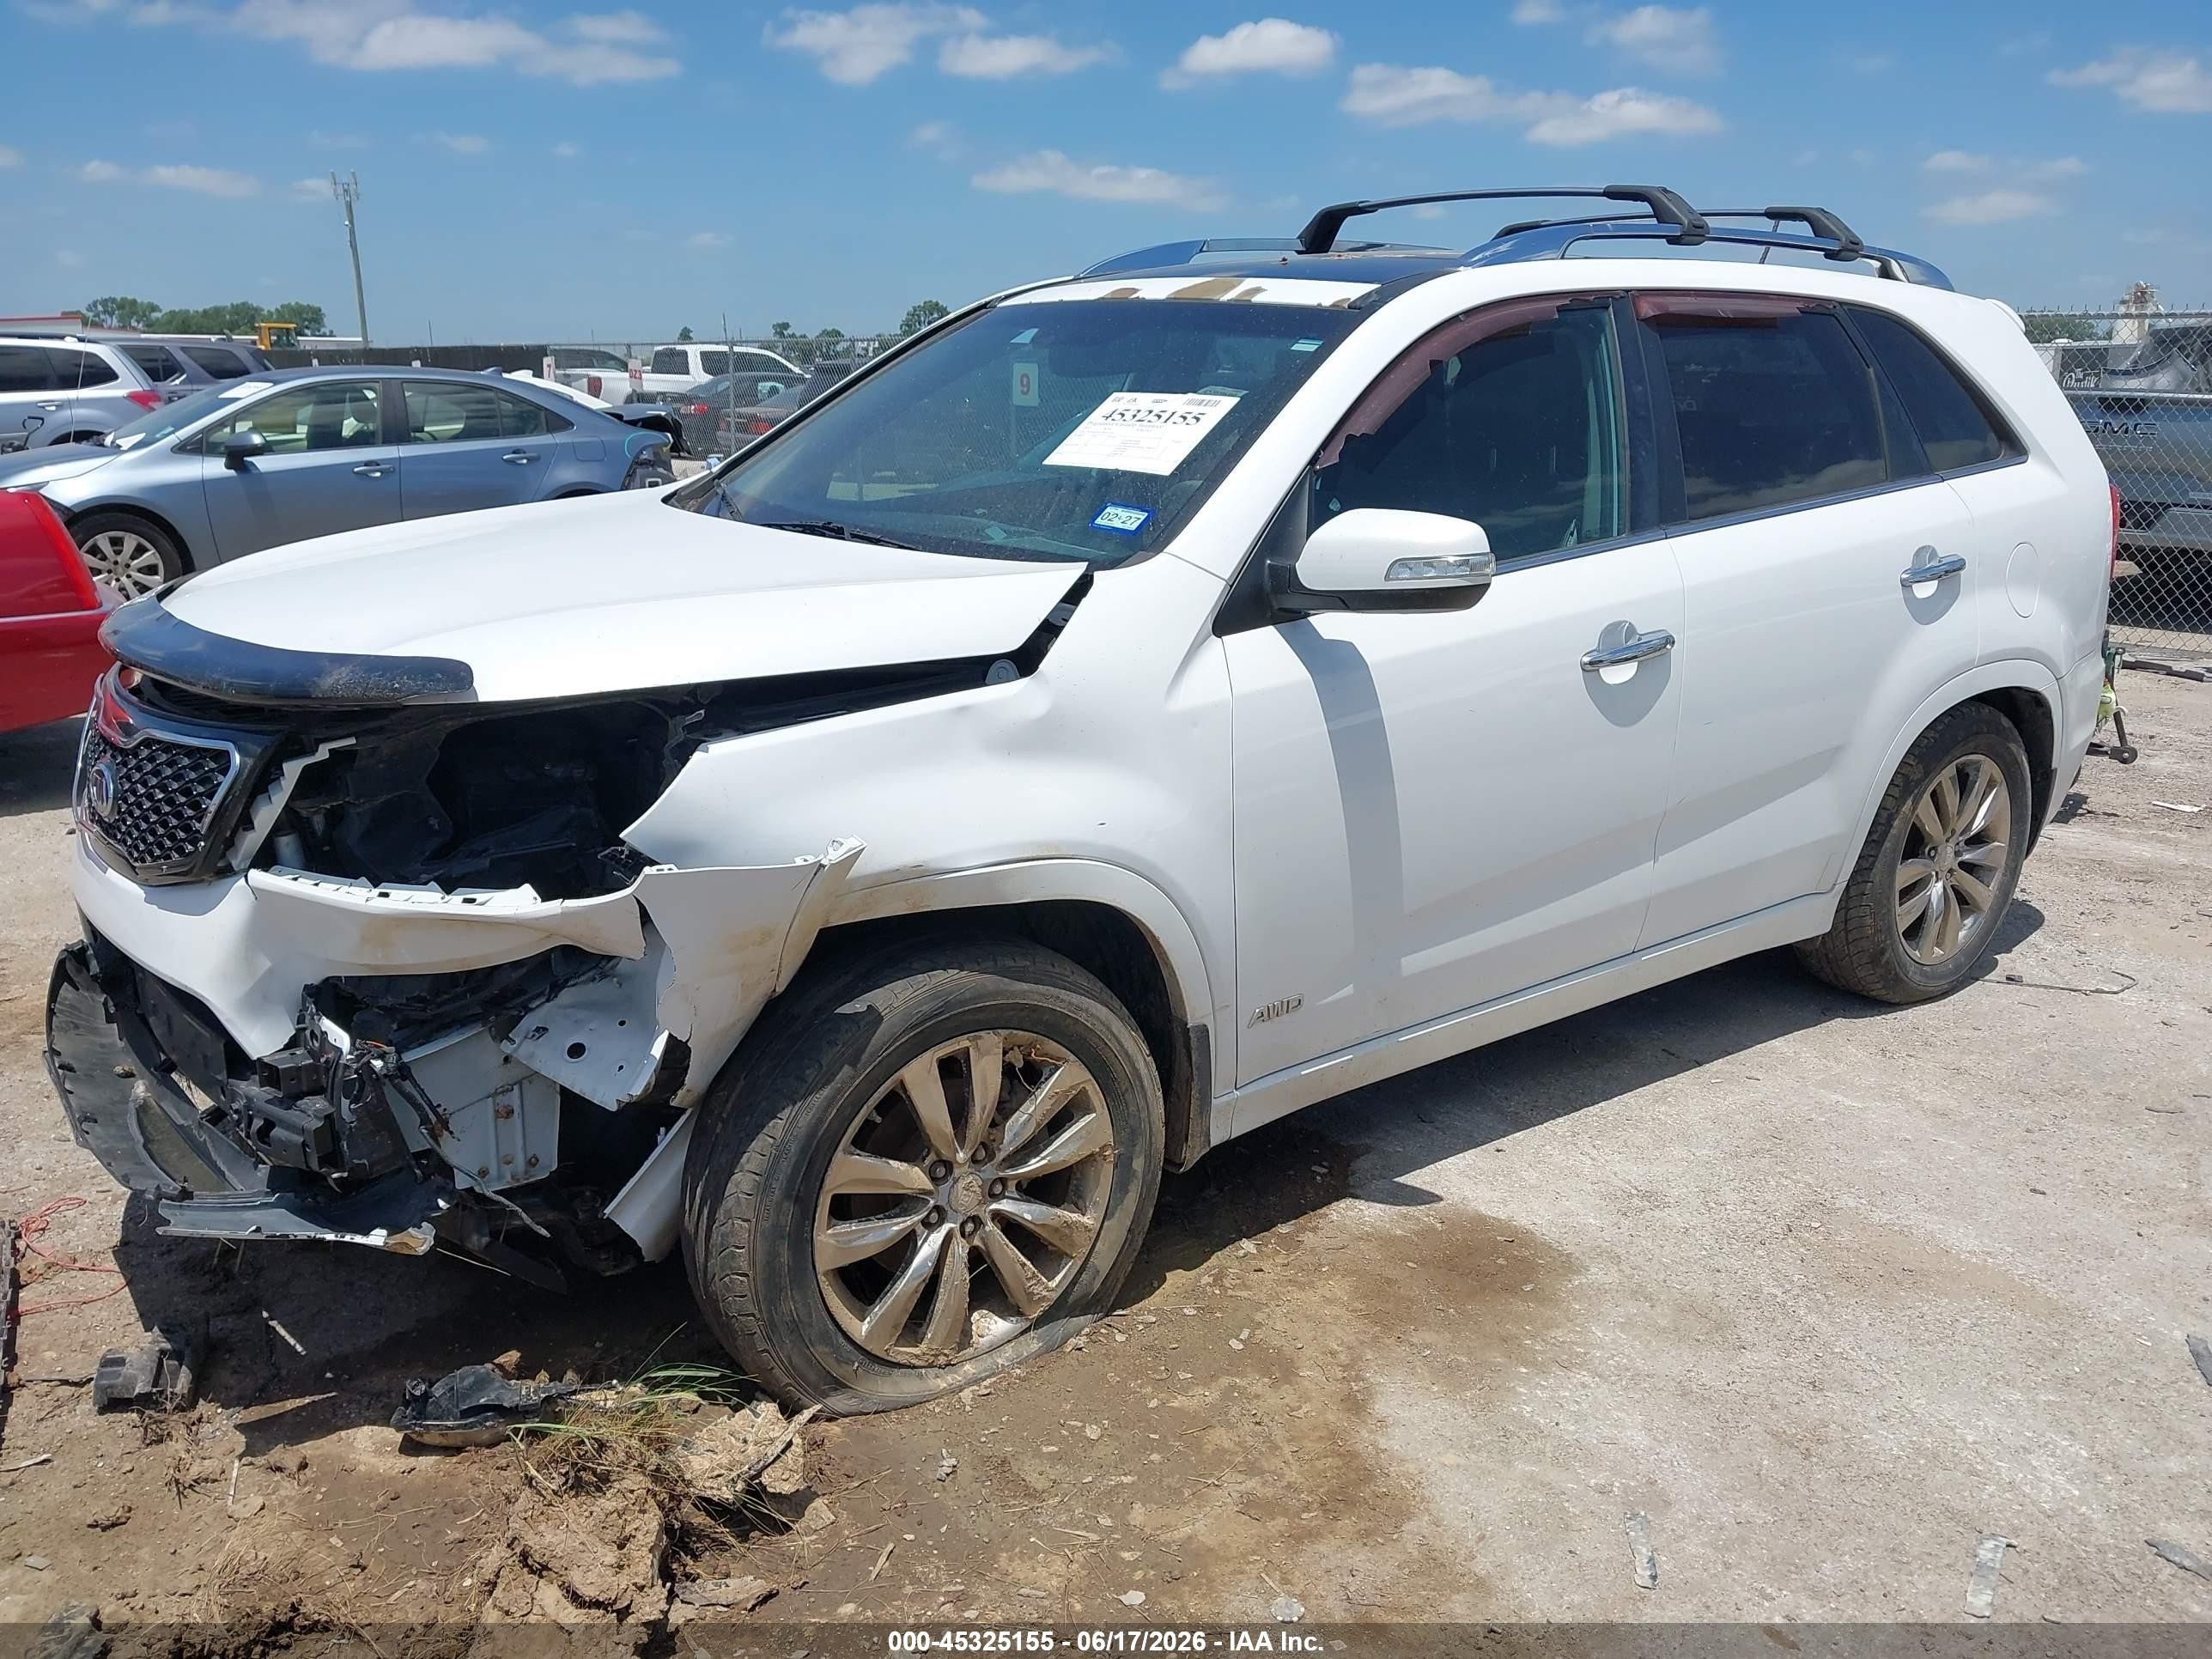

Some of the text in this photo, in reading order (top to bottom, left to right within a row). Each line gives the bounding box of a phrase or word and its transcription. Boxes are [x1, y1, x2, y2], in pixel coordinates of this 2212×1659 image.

[1019, 373, 1031, 396] 9
[1102, 408, 1207, 426] 45325155
[1248, 993, 1305, 1029] AWD
